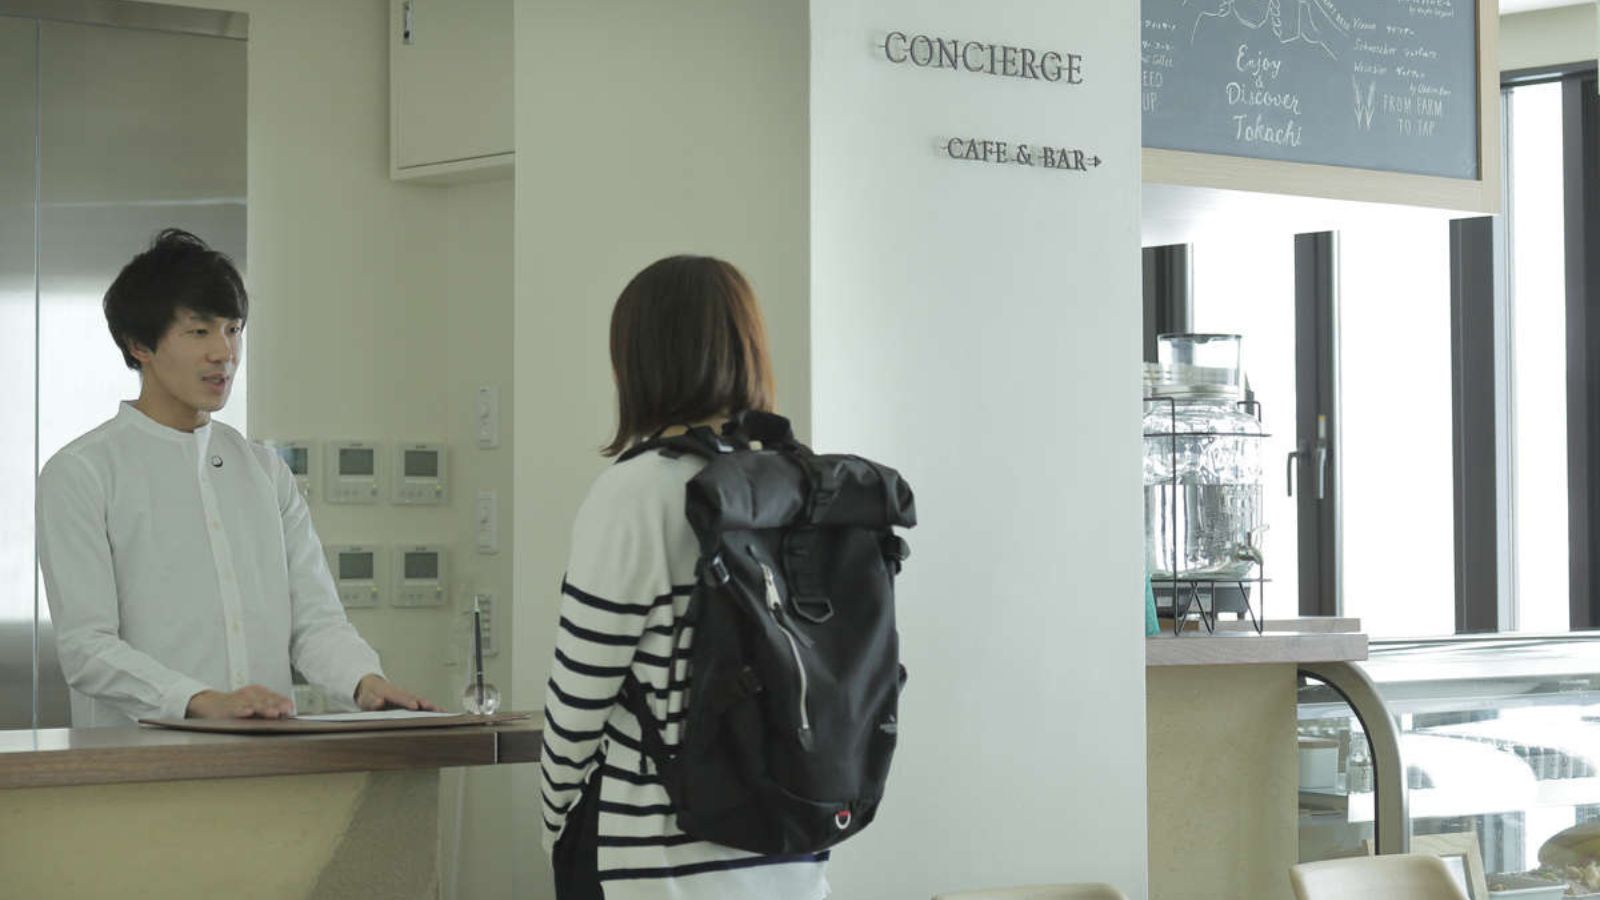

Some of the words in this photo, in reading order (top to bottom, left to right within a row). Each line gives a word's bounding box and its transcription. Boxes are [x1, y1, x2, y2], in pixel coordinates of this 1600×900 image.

[884, 31, 1083, 85] CONCIERGE
[1236, 44, 1281, 79] Enjoy
[1226, 82, 1301, 115] Discover
[1383, 94, 1411, 115] FROM
[1416, 96, 1442, 118] FARM
[1233, 114, 1302, 147] Tokachi
[1398, 118, 1411, 135] TO
[947, 137, 1008, 164] CAFE
[1016, 144, 1034, 166] &
[1043, 146, 1087, 171] BAR
